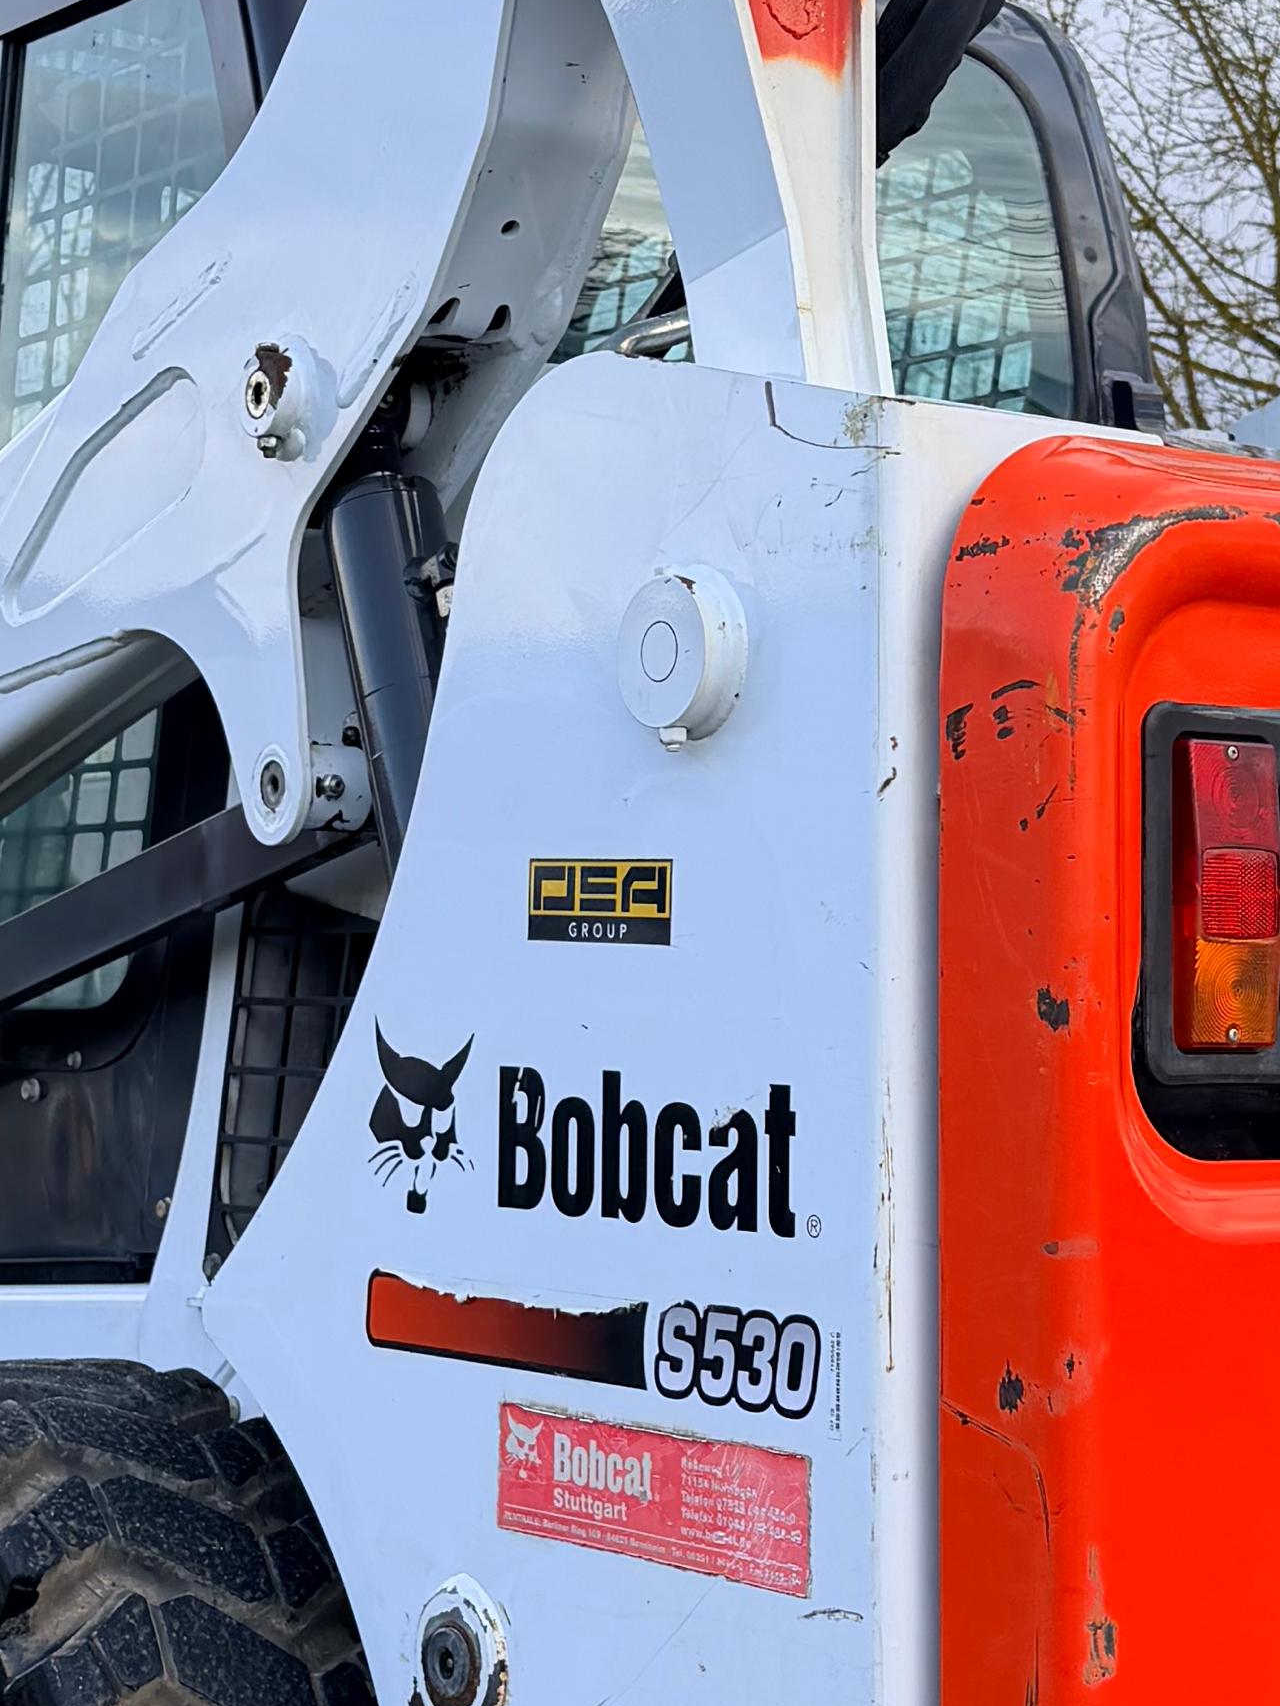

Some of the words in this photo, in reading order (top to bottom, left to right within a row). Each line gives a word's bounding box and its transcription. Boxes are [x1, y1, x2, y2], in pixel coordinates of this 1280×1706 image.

[568, 921, 628, 940] GROUP
[497, 1065, 797, 1239] Bobcat
[656, 1302, 819, 1416] S530
[553, 1431, 653, 1503] Bobcat
[553, 1487, 628, 1522] Stuttgart
